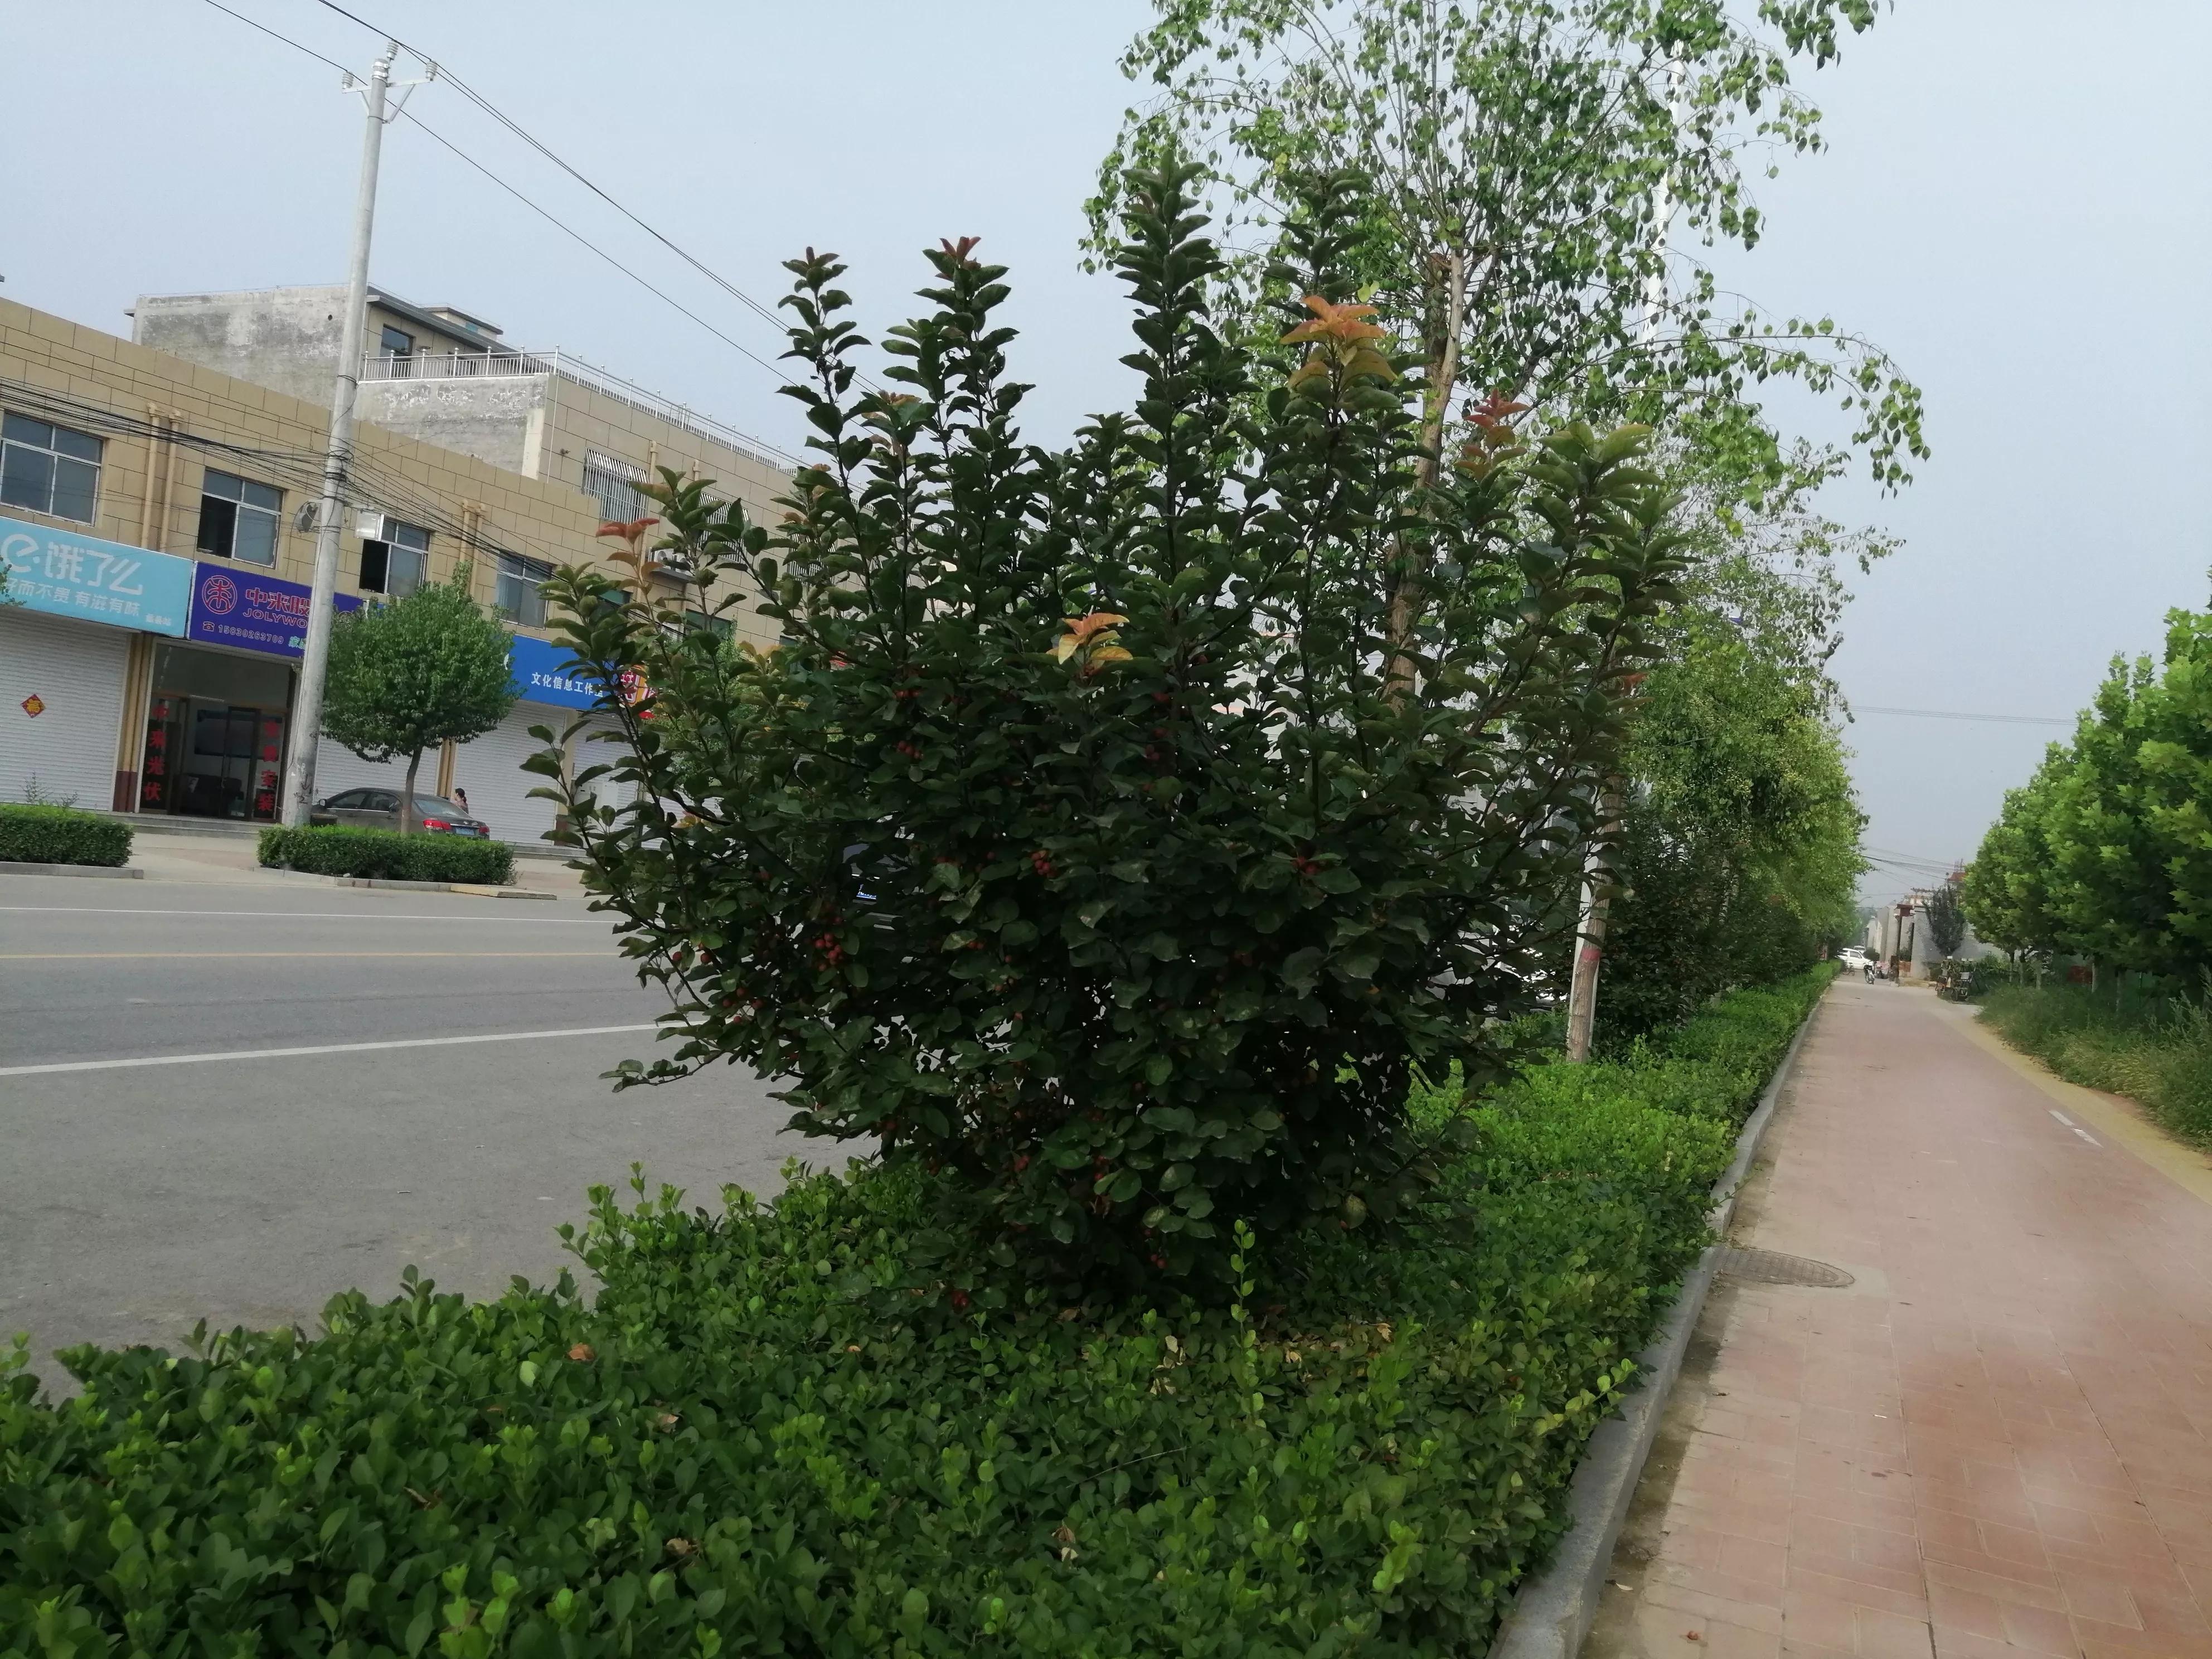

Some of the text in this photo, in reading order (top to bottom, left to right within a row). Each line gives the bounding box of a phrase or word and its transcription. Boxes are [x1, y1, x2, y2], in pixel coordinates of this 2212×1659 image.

[44, 541, 143, 595] 饿了么
[75, 591, 140, 616] 有滋有味
[218, 624, 284, 644] 15830263709
